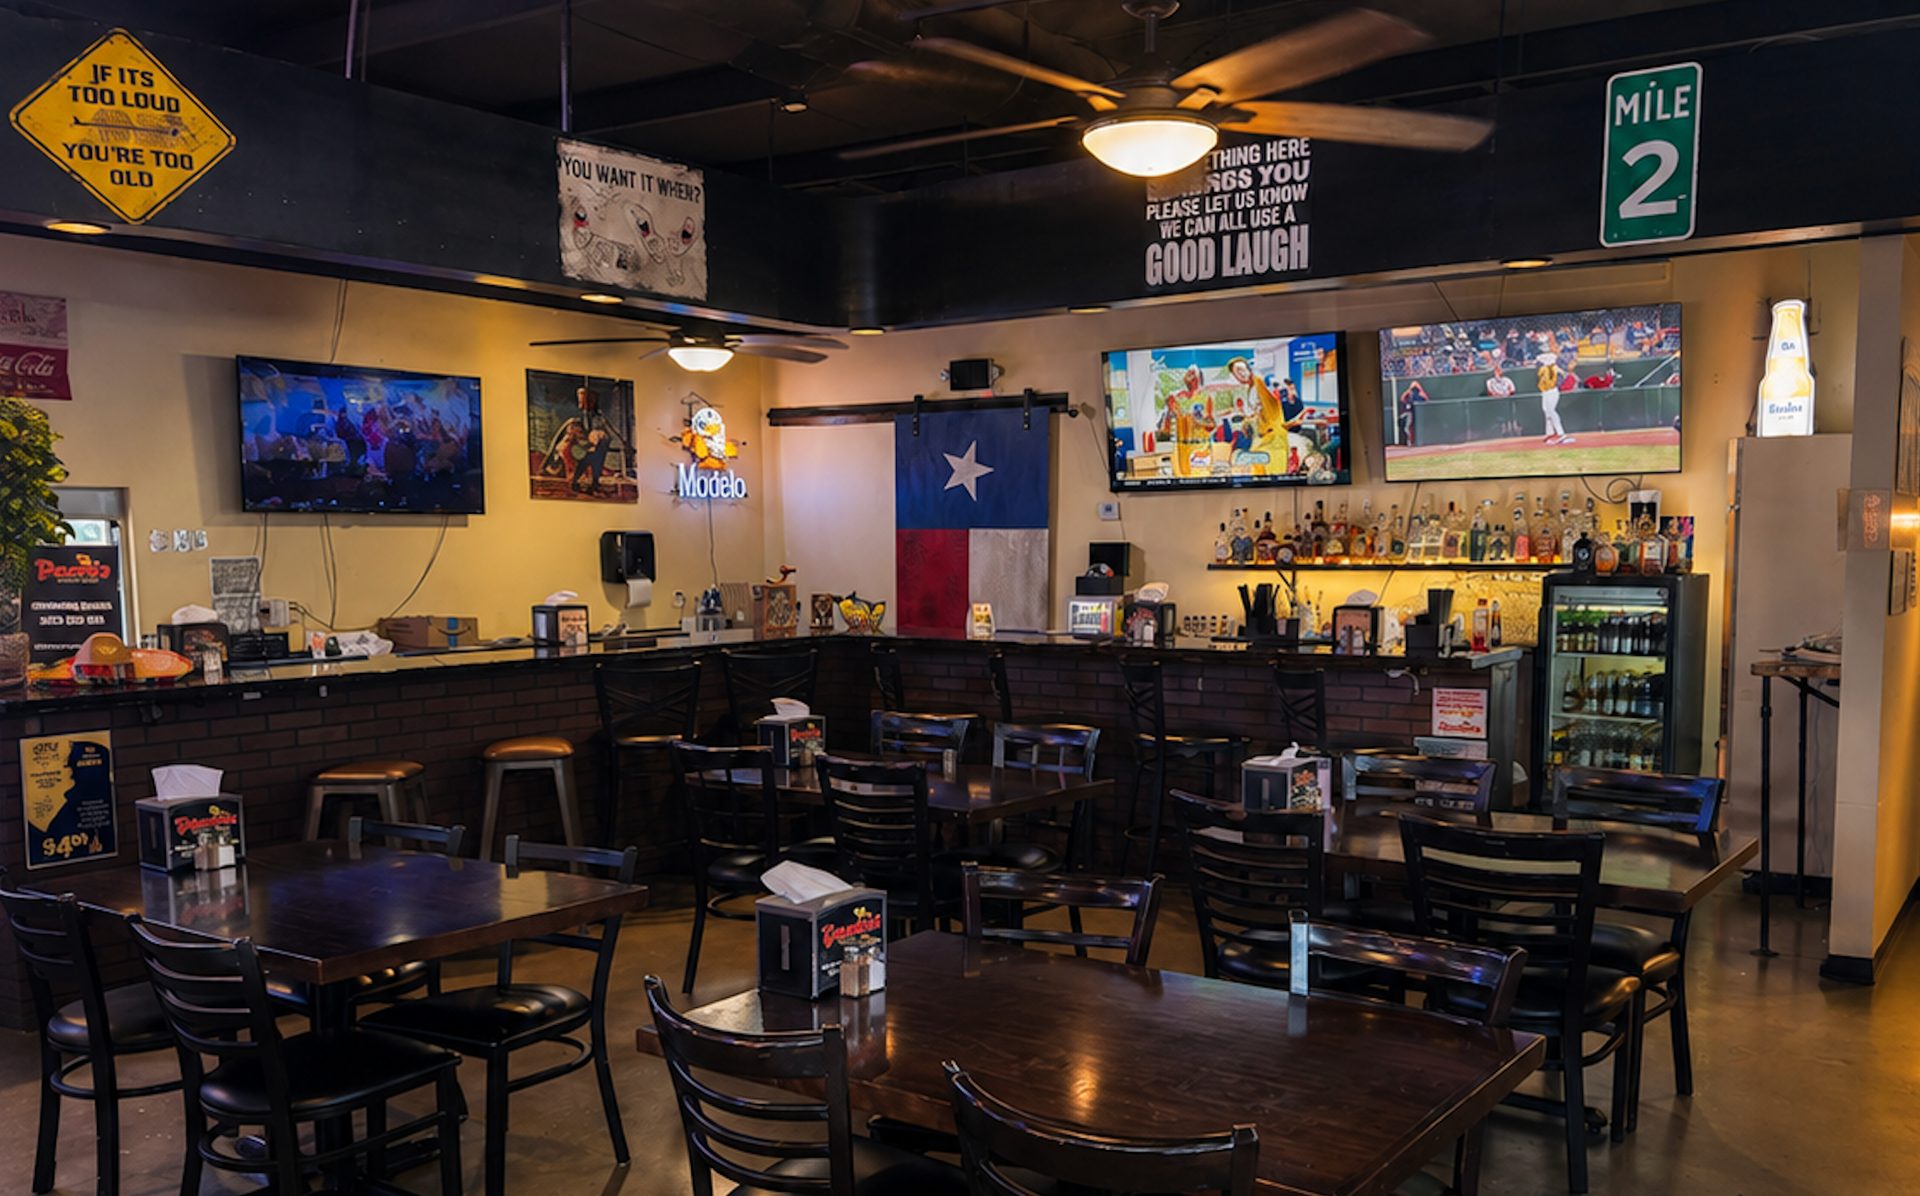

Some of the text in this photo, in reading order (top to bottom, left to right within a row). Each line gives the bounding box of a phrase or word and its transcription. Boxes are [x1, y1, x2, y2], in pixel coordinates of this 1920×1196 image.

[90, 64, 154, 88] IF ITS
[67, 85, 180, 114] TOO LOUD
[1615, 84, 1691, 126] MILE
[63, 143, 194, 171] YOU'RE TOO
[1266, 137, 1311, 162] HERE
[110, 169, 153, 188] OLD
[563, 156, 702, 204] YOU WANT IT WHEN?
[1258, 160, 1310, 186] YOU
[1618, 139, 1680, 219] 2
[1146, 183, 1308, 221] PLEASE LET US KNOW
[1159, 204, 1296, 239] WE CAN ALL USE A
[1145, 224, 1309, 286] GOOD LAUGH
[678, 463, 746, 497] Modelo
